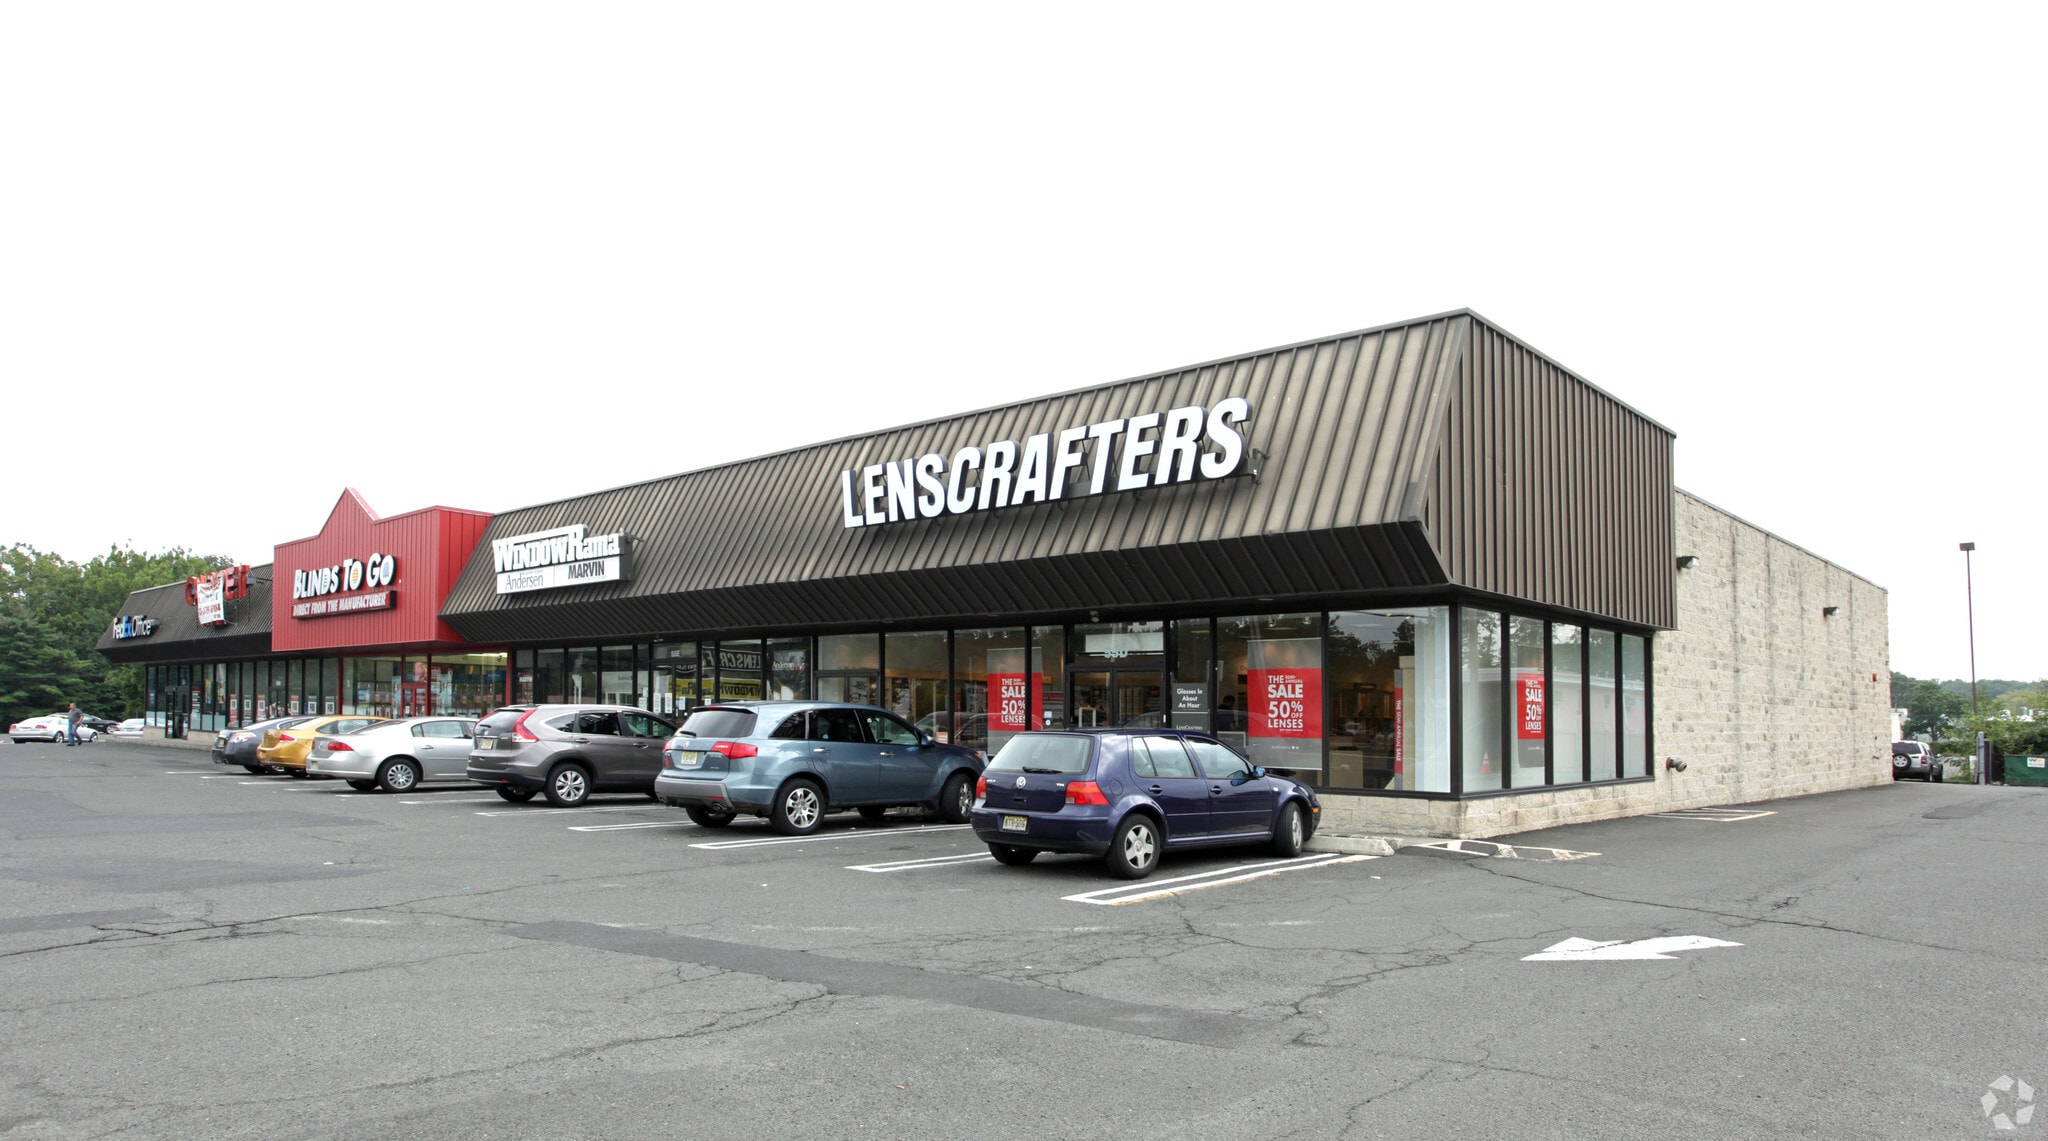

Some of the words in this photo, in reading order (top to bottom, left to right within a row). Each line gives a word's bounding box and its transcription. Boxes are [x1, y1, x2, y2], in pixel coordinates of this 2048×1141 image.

[842, 397, 1250, 528] LENSCRAFTERS
[293, 565, 340, 599] BLINDS
[343, 558, 363, 591] TO
[366, 552, 395, 588] GO
[568, 560, 605, 579] MARVIN
[505, 573, 544, 591] Andersen
[293, 602, 310, 617] DIRECT
[311, 601, 327, 615] FROM
[328, 599, 338, 612] THE
[339, 593, 386, 611] MANUFACTURER
[113, 615, 132, 639] FedEx
[131, 614, 152, 637] Office
[1268, 675, 1284, 684] THE
[1525, 680, 1533, 688] THE
[1001, 686, 1025, 698] SALE
[1267, 684, 1303, 698] SALE
[1525, 688, 1542, 702] SALE
[1268, 701, 1303, 718] 50%
[1267, 719, 1303, 729] LENSES
[1525, 721, 1542, 730] LENSES
